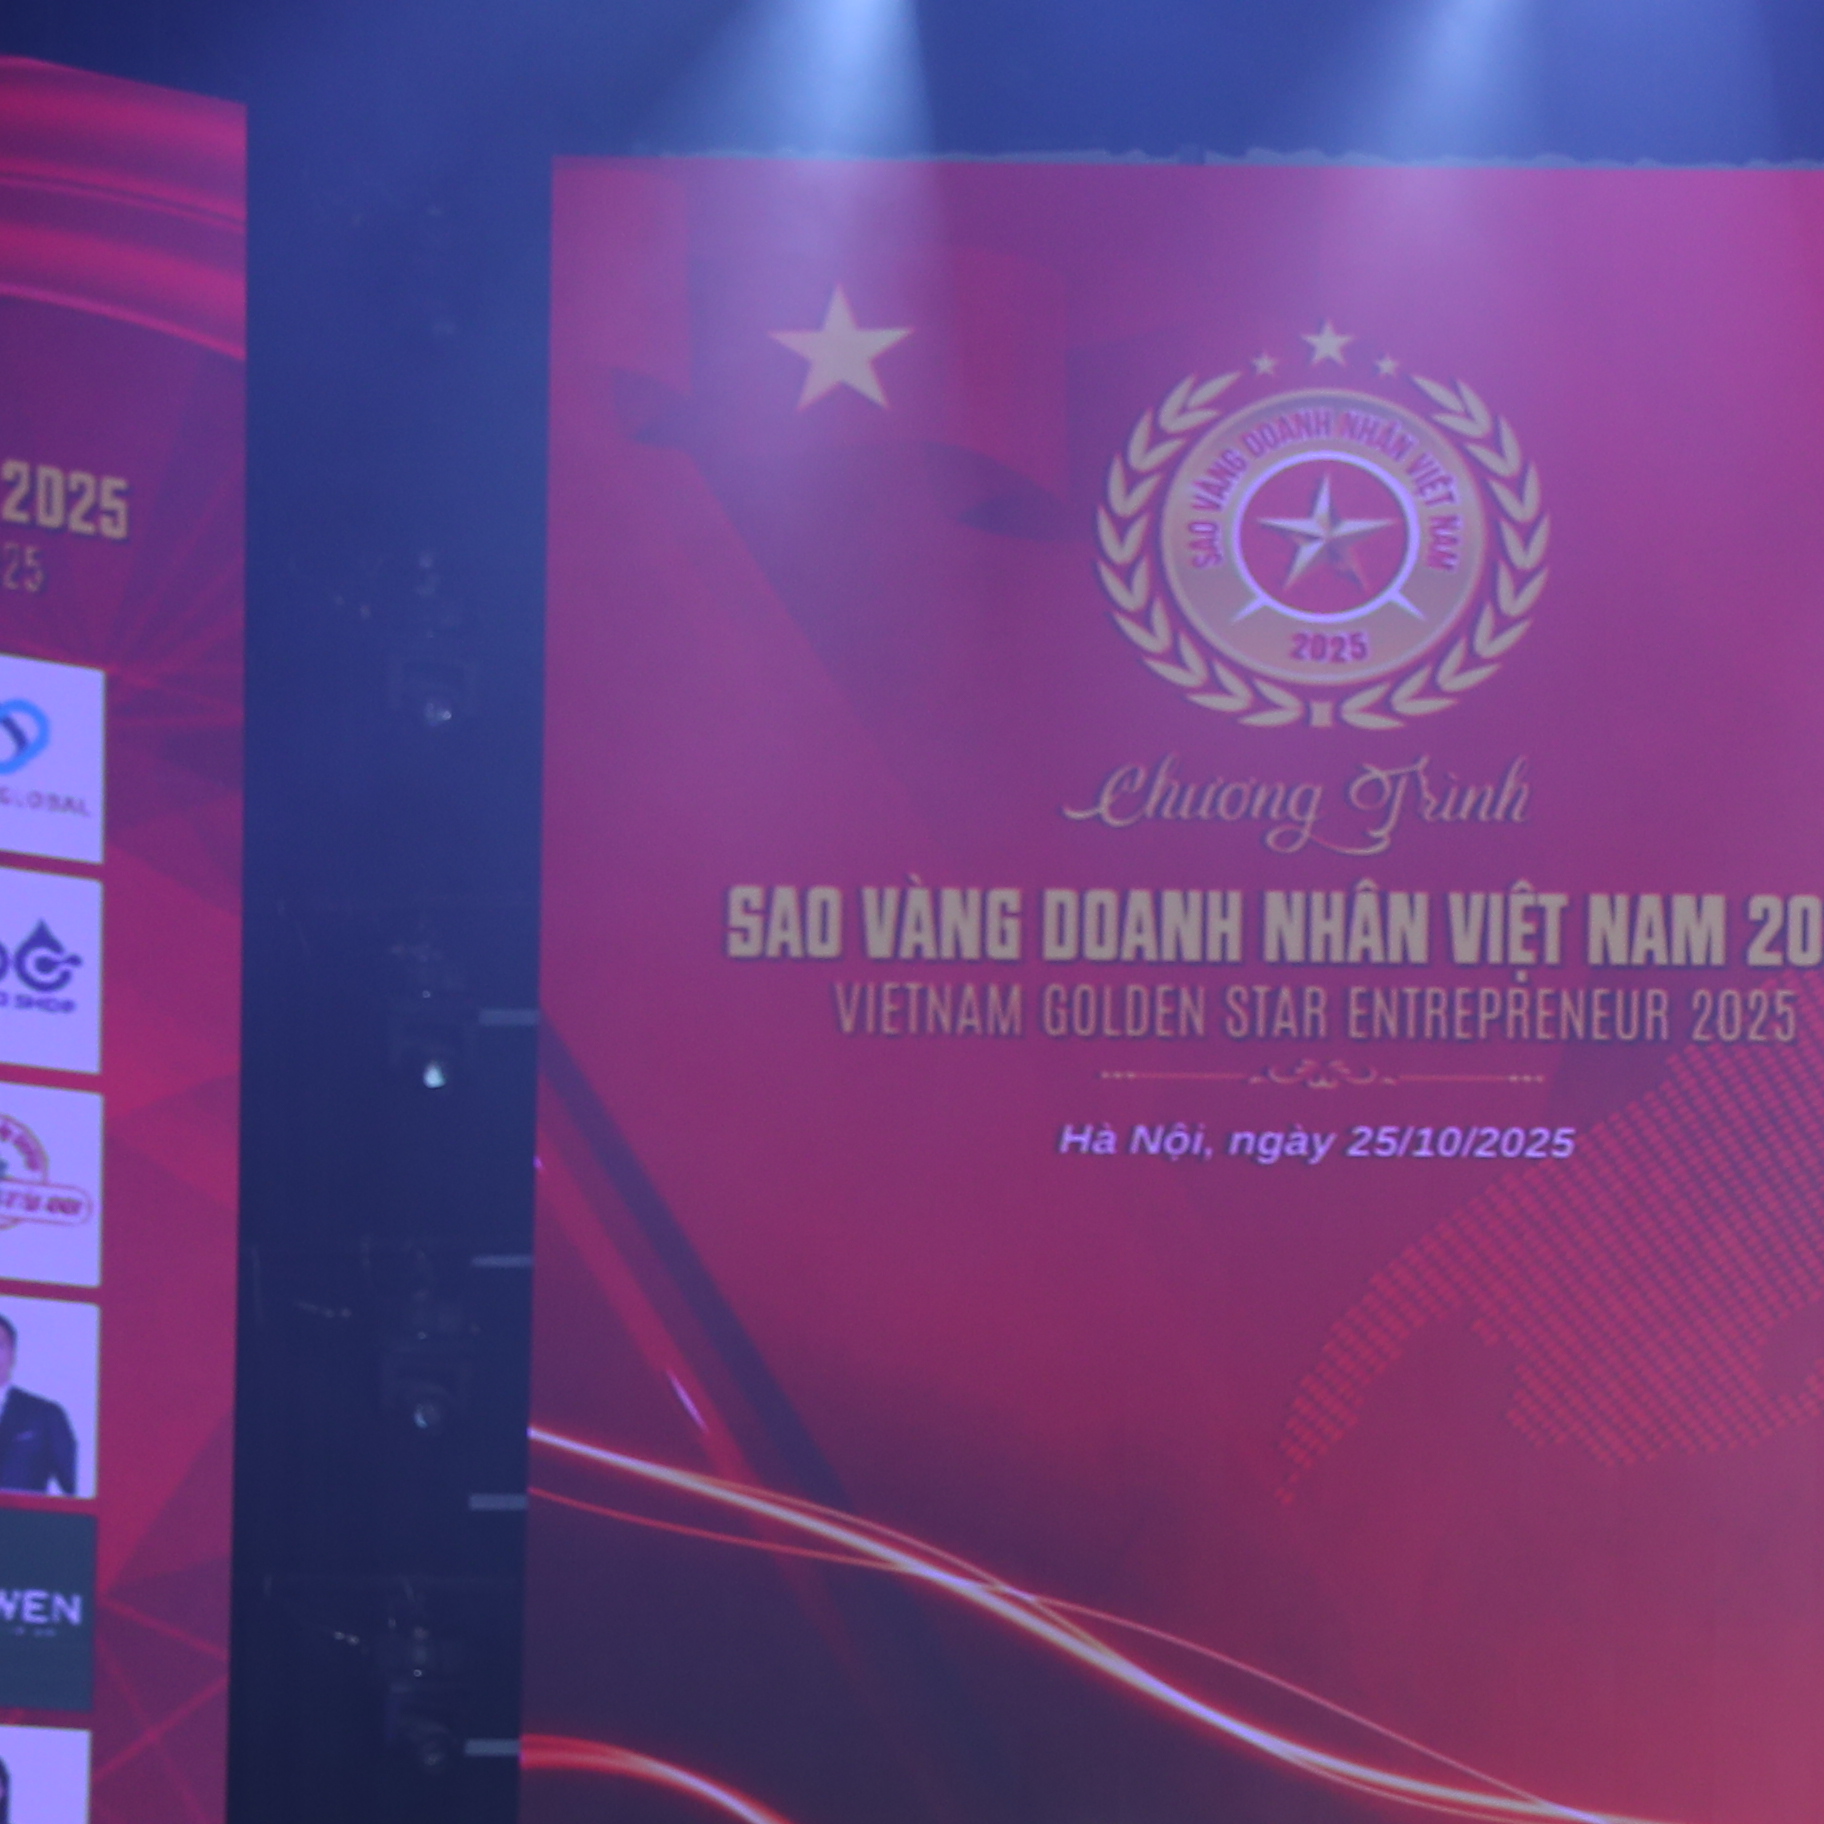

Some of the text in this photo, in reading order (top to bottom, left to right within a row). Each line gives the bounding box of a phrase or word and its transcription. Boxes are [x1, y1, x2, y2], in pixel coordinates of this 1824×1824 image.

[2, 458, 129, 540] 2025
[1289, 631, 1370, 663] 2025
[1061, 751, 1531, 854] Chương Trình
[726, 884, 842, 959] SAO
[862, 873, 1022, 961] VÀNG
[1042, 888, 1243, 963] DOANH
[1263, 877, 1429, 966] NHÂN
[1448, 877, 1569, 984] VIỆT
[1588, 892, 1726, 967] NAM
[833, 982, 1798, 1043] VIETNAM GOLDEN STAR ENTREPRENEUR 2025
[1059, 1121, 1578, 1165] Hà Nội, ngày 25/10/2025
